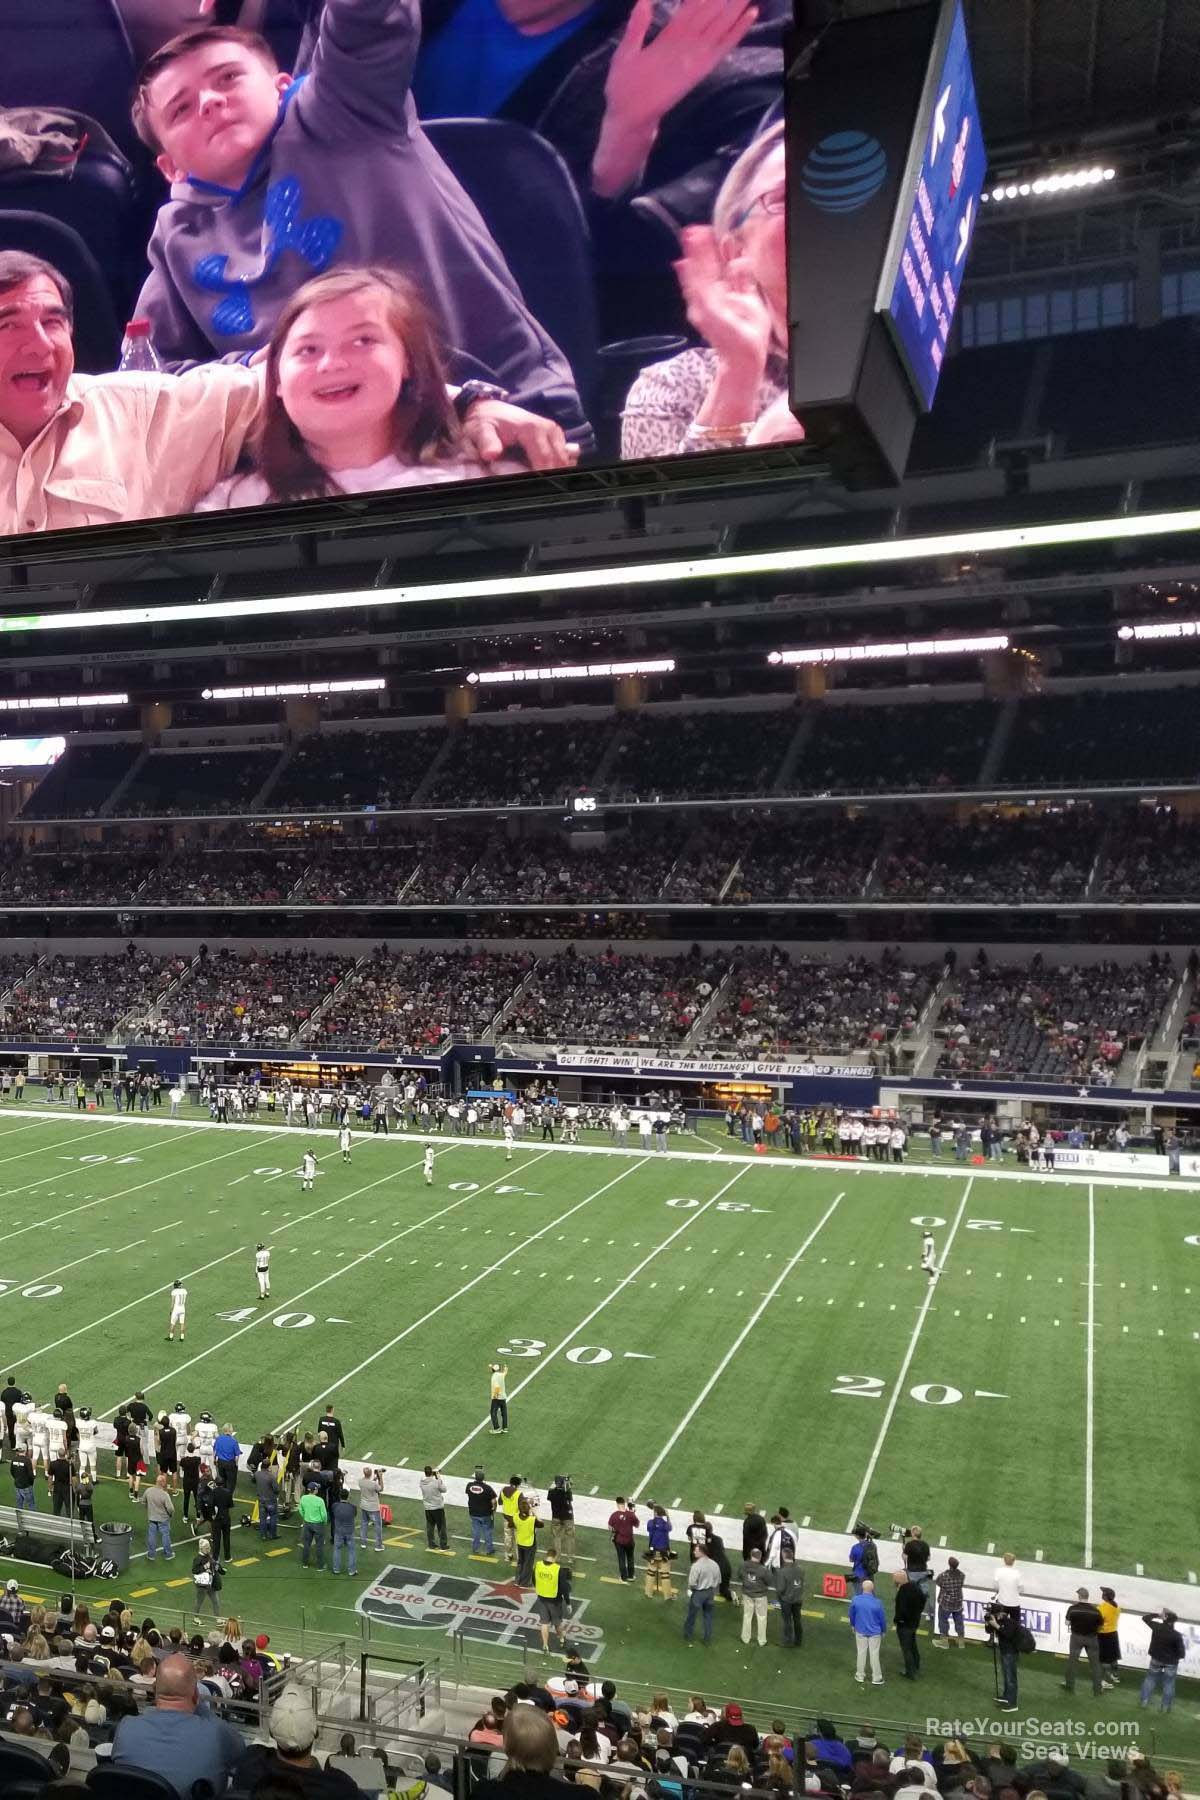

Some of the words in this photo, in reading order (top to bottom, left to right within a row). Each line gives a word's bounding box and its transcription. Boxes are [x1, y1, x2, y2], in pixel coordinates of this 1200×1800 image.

[579, 1057, 609, 1066] FIGHT!
[612, 1058, 635, 1066] WIN!
[639, 1058, 655, 1067] WE
[657, 1060, 675, 1068] ARE
[679, 1061, 696, 1069] THE
[699, 1062, 750, 1071] MUSTANGS!
[757, 1063, 783, 1072] GIVE
[214, 1307, 317, 1328] 40
[496, 1338, 613, 1364] 30
[830, 1375, 963, 1405] 20
[825, 1577, 842, 1594] 20
[370, 1586, 425, 1605] State
